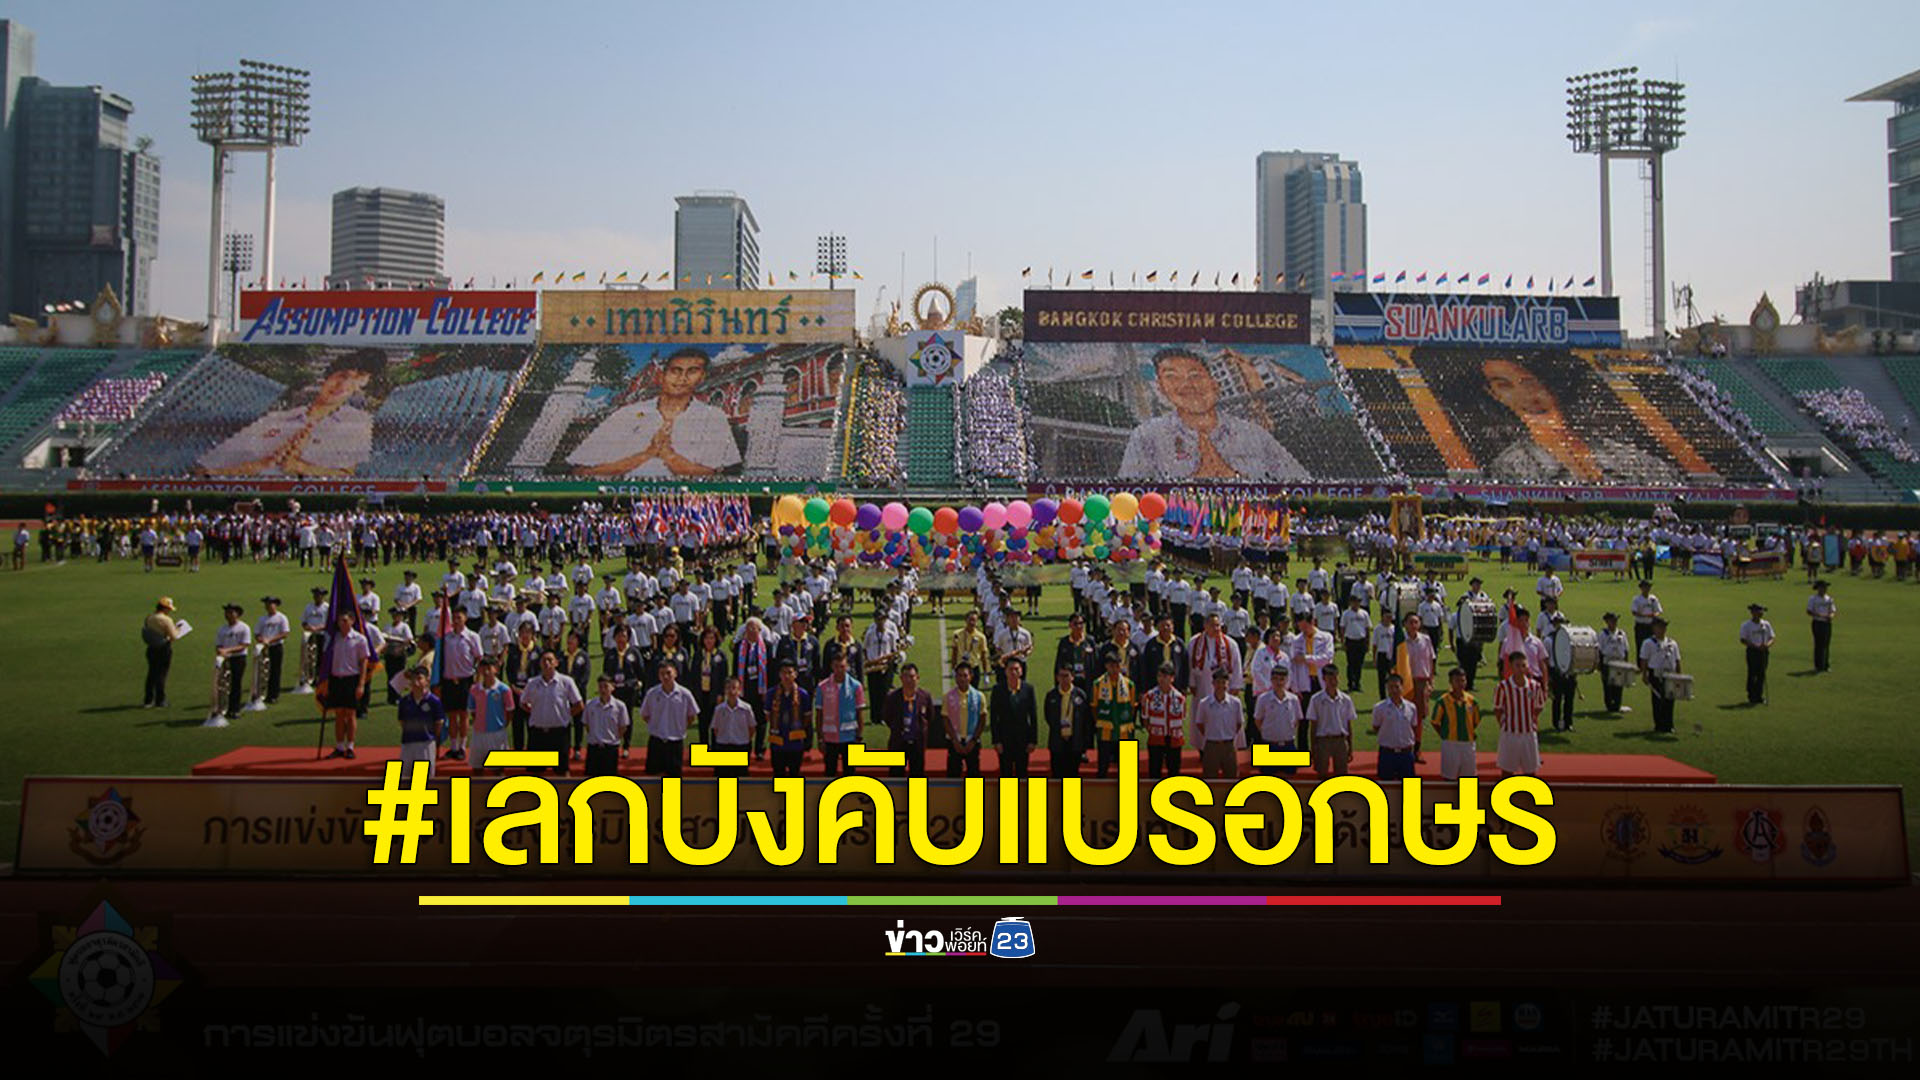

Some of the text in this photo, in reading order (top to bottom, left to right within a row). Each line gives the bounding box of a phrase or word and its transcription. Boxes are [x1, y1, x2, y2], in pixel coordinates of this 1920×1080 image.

[605, 294, 794, 336] เทพศิรินทร์
[1038, 310, 1299, 330] BANGKOK CHRISTIAN COLLEGE
[1384, 303, 1570, 344] SUANKULARB
[1480, 489, 1734, 502] SUANKULRB WITTYALAI
